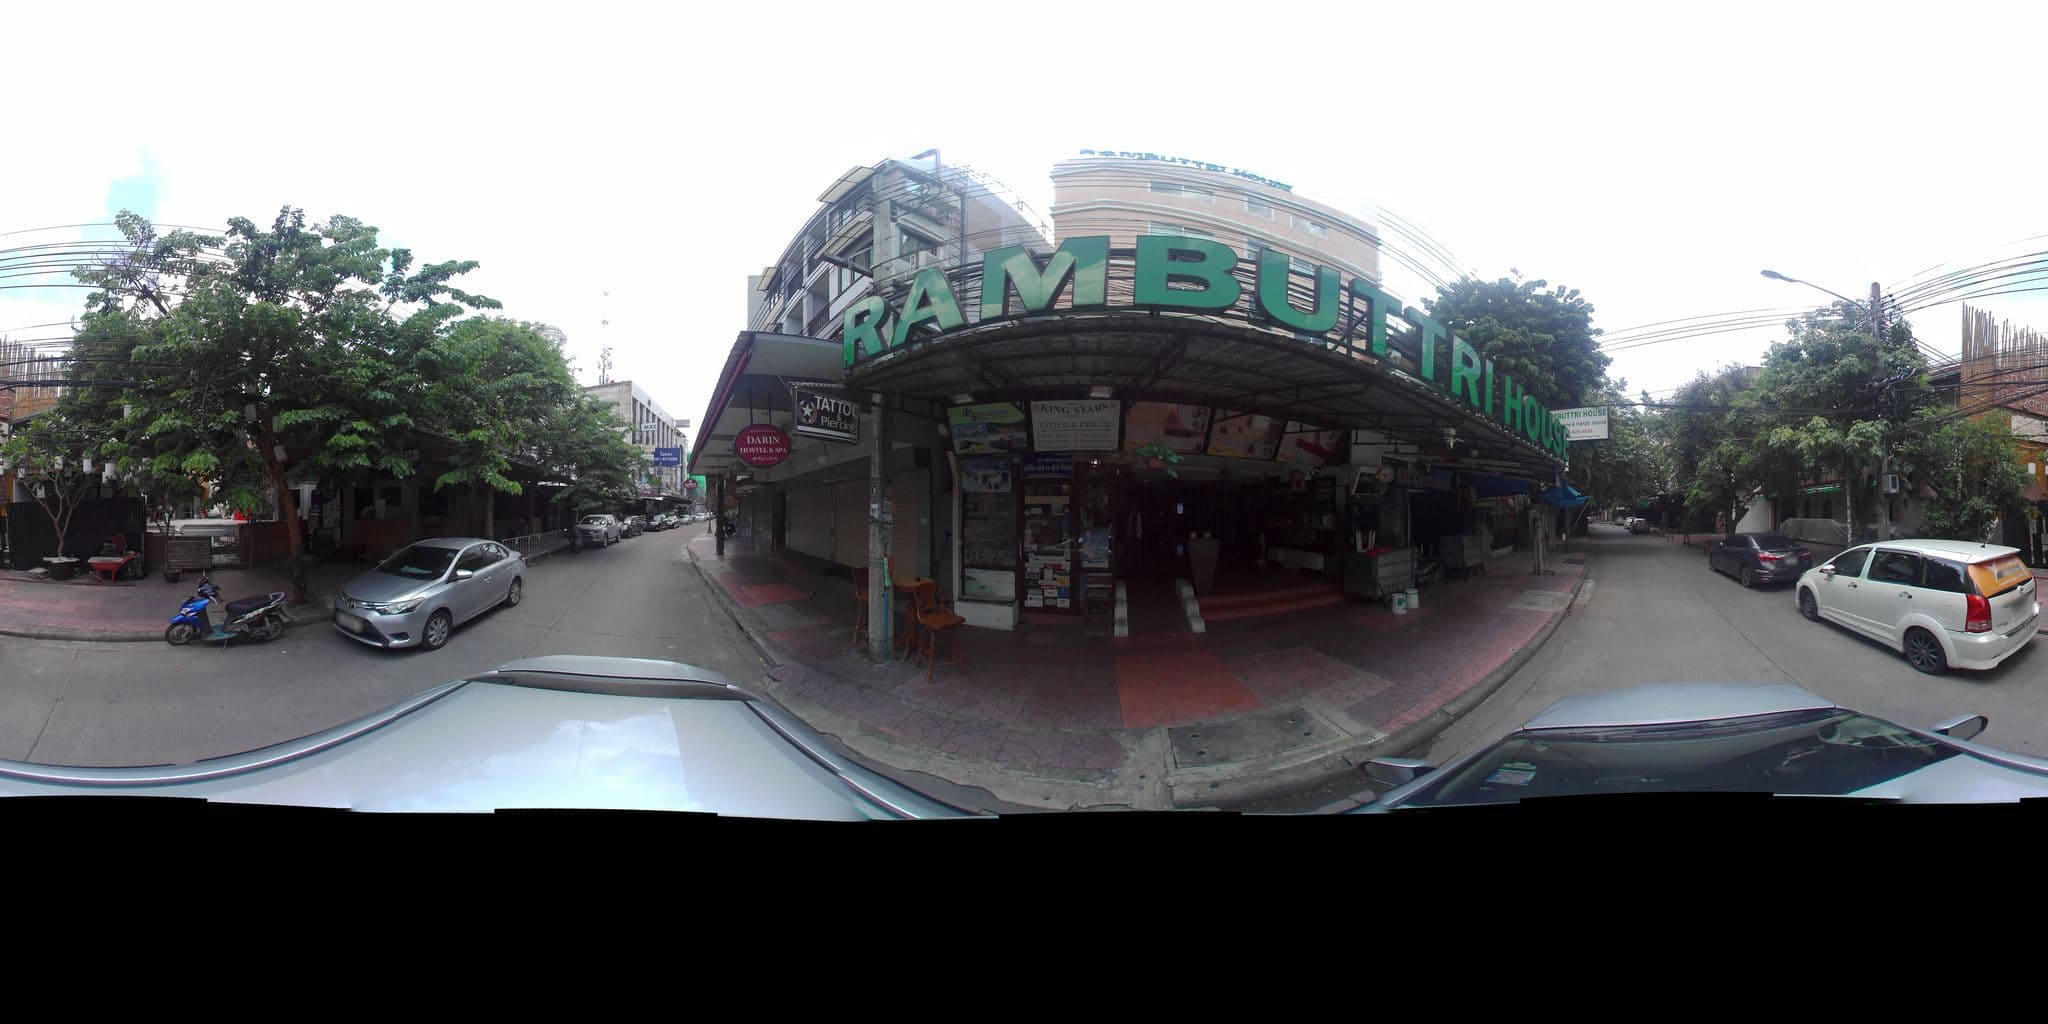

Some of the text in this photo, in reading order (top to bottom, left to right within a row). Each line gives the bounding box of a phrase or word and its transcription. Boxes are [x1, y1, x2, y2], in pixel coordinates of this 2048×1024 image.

[843, 235, 1569, 463] RAMBUTTRI HOUSE
[1041, 404, 1069, 415] KING
[1583, 408, 1606, 418] HOUSE
[746, 436, 780, 444] DARIN
